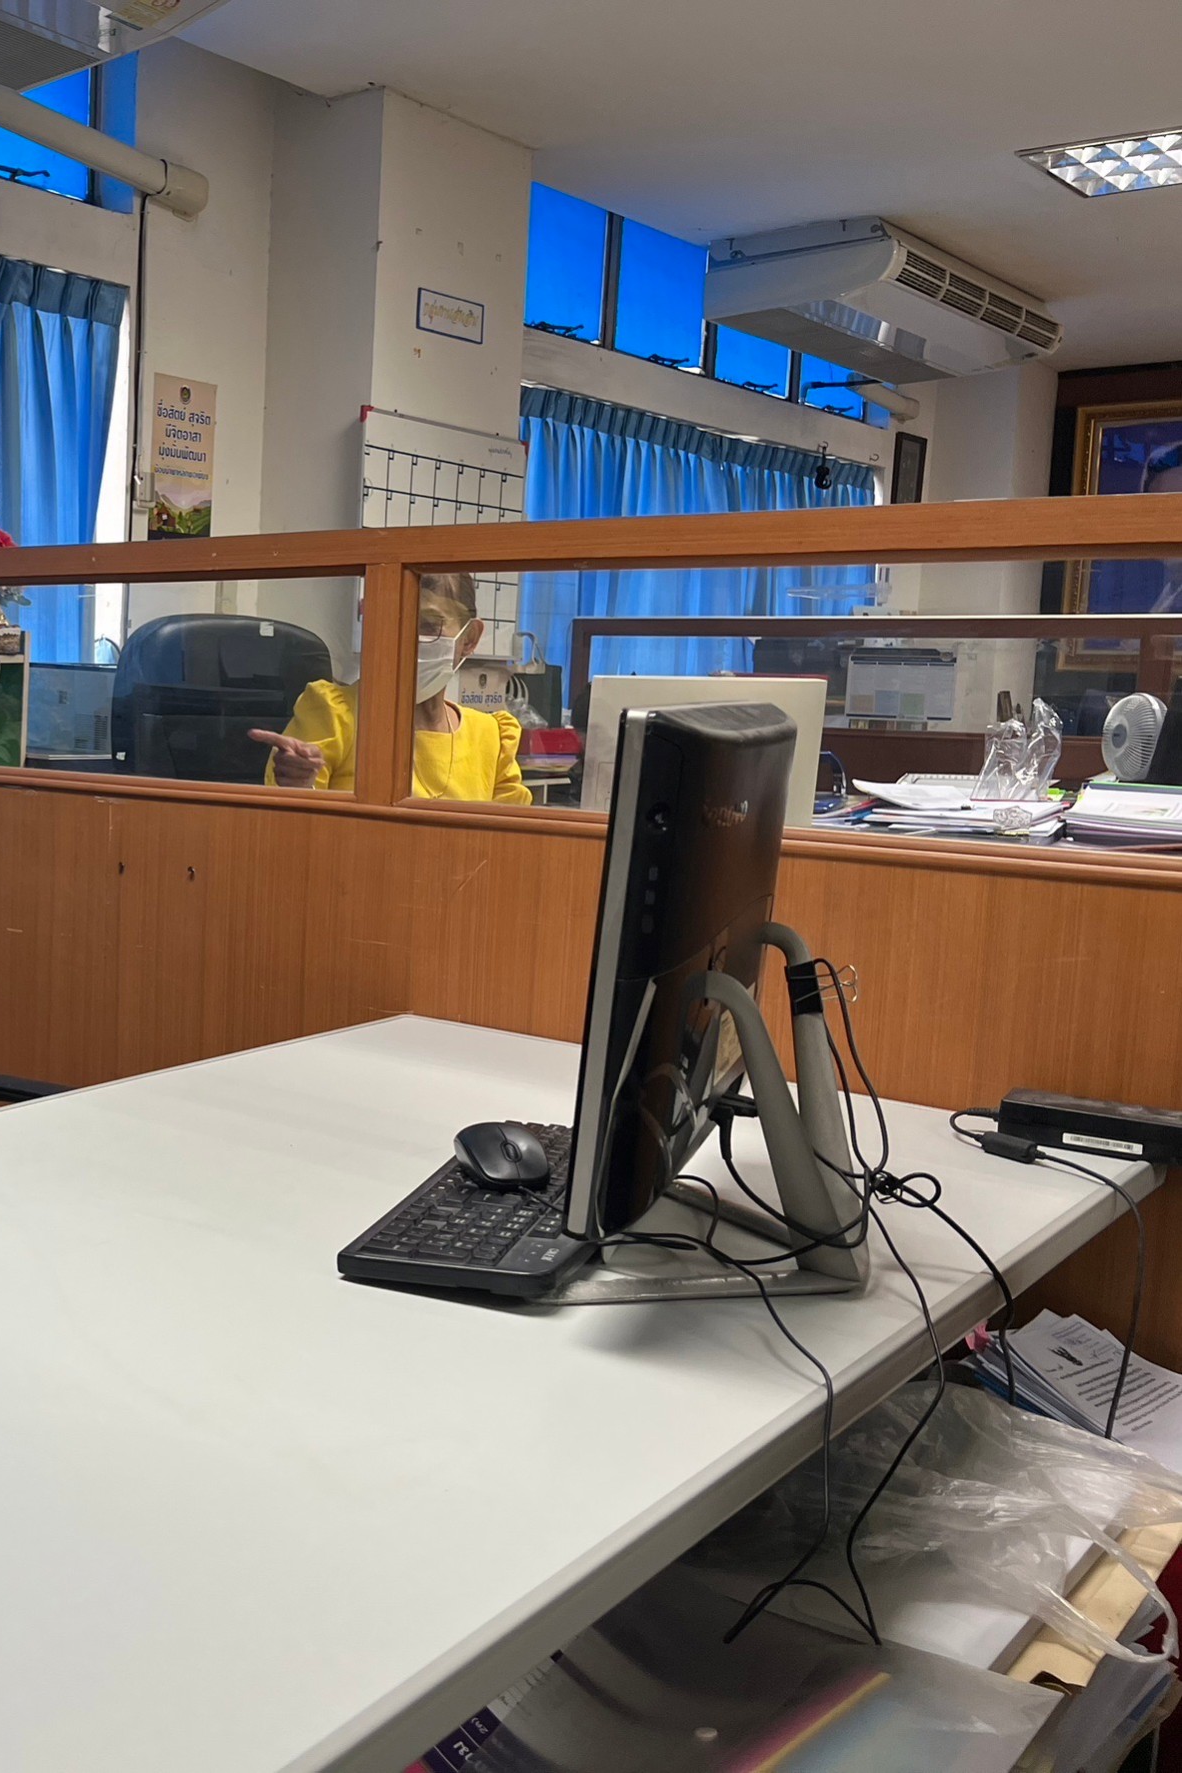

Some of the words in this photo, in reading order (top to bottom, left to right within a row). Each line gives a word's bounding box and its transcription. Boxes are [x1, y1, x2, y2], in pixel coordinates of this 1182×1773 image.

[189, 410, 212, 427] สุจริต
[164, 424, 202, 443] มีจิตอาสา
[158, 440, 207, 463] มุ่งมั่นพัฒนา
